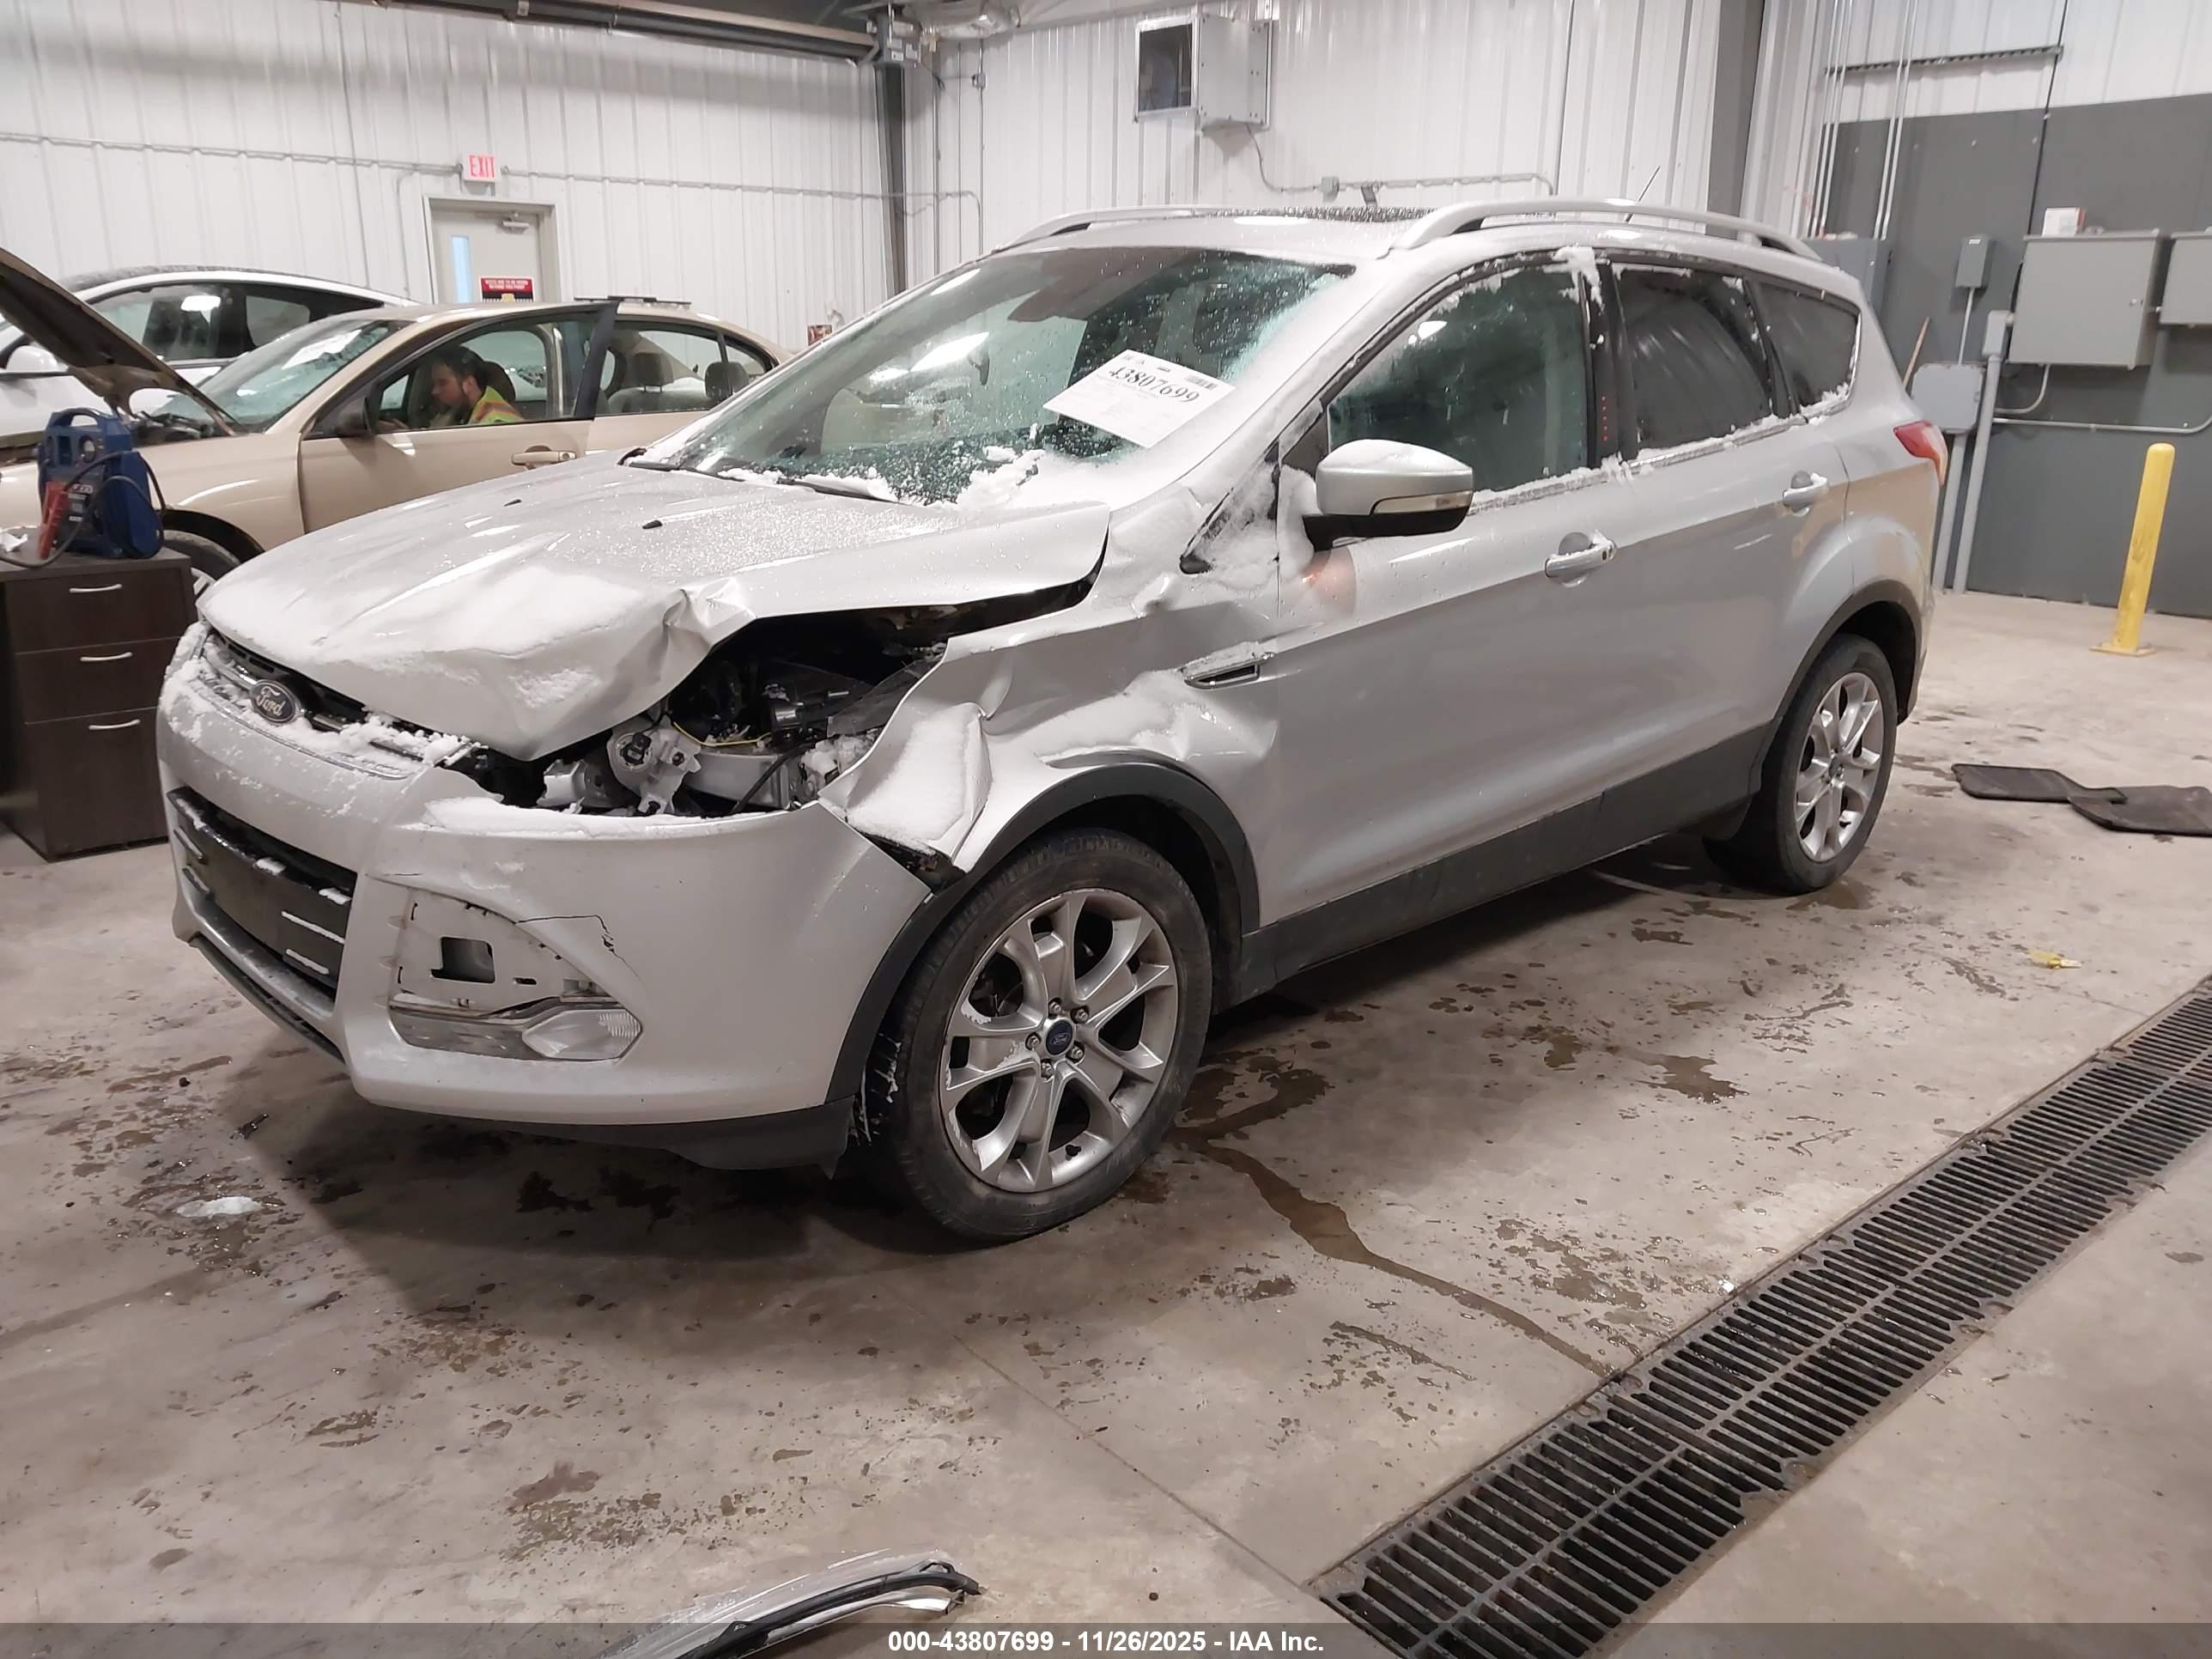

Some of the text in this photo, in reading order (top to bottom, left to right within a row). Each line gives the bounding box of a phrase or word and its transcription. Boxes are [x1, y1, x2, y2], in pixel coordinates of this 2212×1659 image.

[469, 155, 495, 178] EXIT
[1109, 366, 1200, 403] 43807699
[257, 686, 286, 716] Ford
